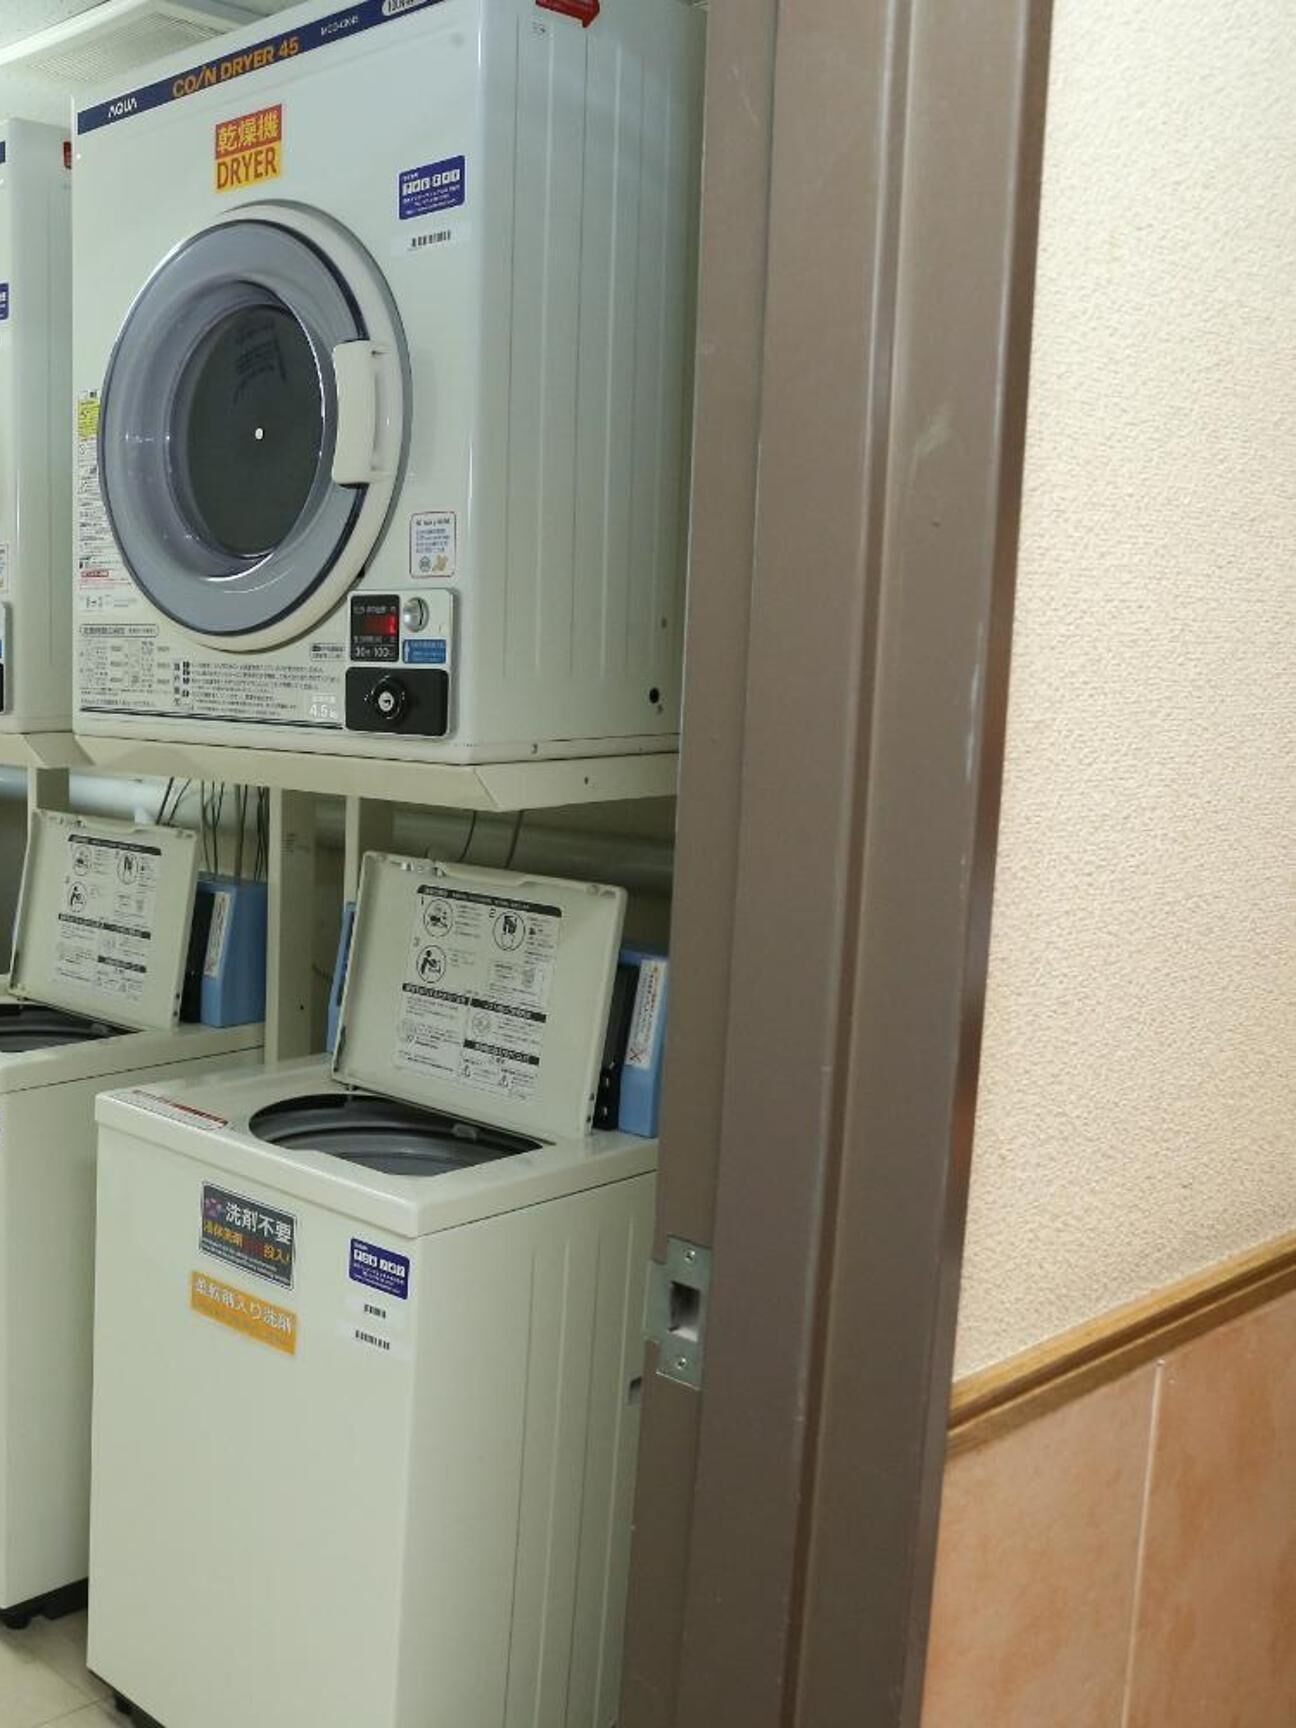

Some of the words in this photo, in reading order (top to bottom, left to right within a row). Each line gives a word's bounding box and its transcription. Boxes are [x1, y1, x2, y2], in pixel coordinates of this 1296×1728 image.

[220, 46, 274, 80] DRYER
[280, 36, 299, 57] 45
[217, 147, 277, 189] DRYER
[225, 1201, 292, 1246] 洗剤不要
